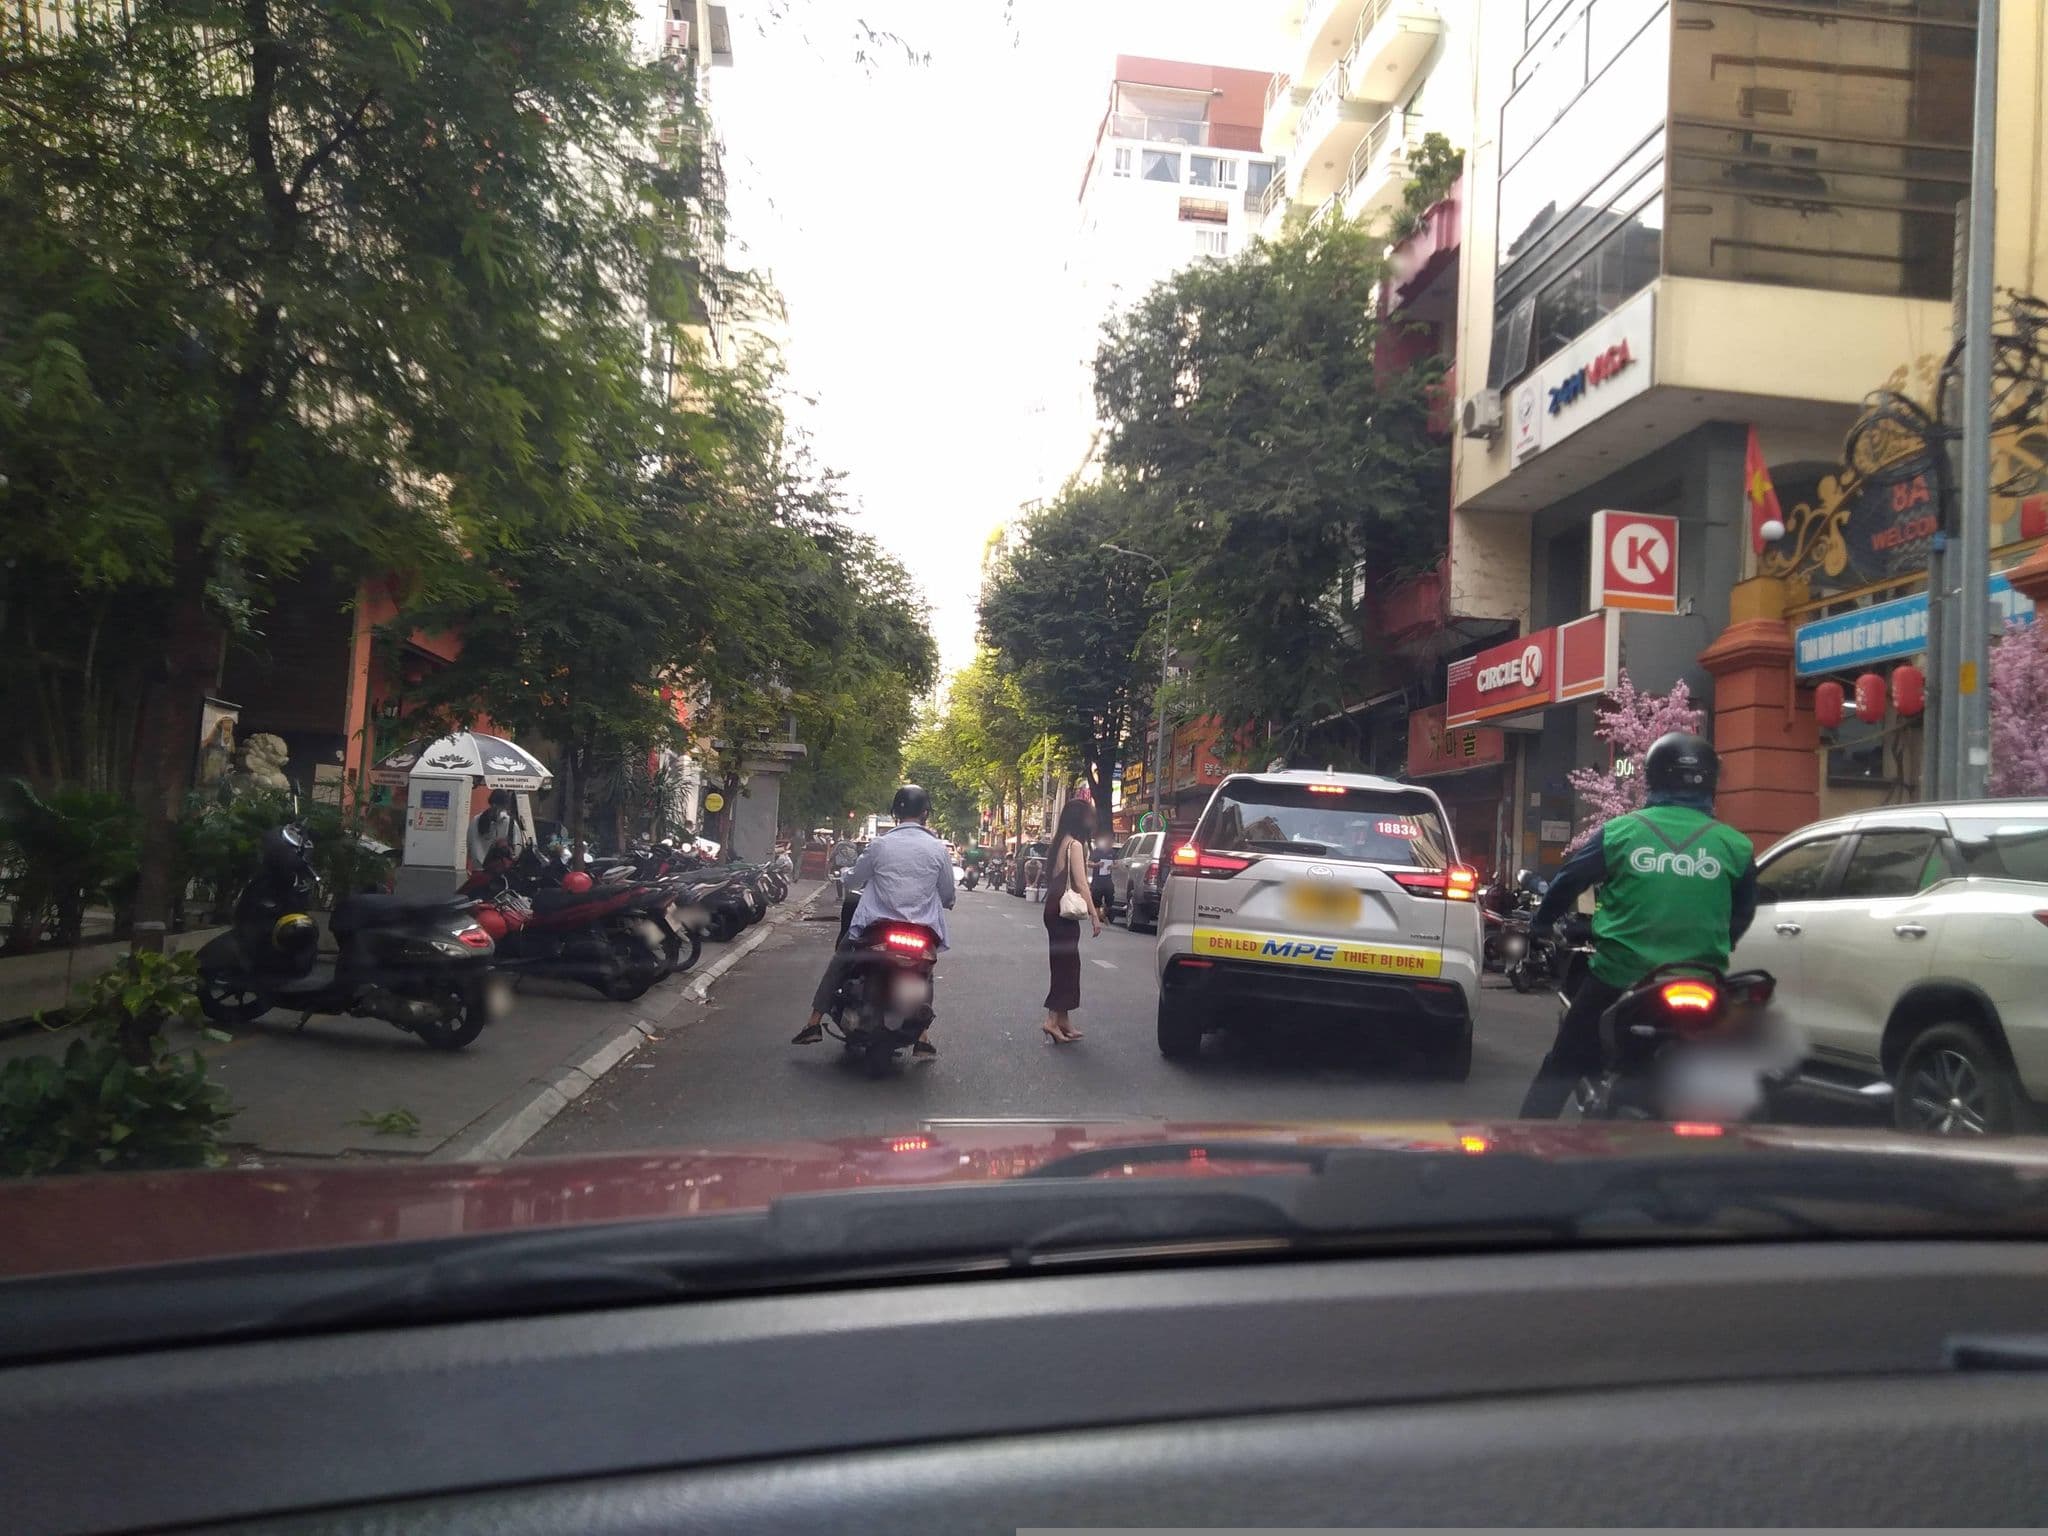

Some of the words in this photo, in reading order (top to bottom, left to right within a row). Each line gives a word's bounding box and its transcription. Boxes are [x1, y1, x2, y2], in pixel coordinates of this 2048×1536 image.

[1477, 659, 1522, 692] CIRCLE
[1378, 822, 1417, 836] 18834
[1630, 847, 1720, 879] Grab
[1236, 940, 1257, 952] LED
[1261, 939, 1338, 961] MPE
